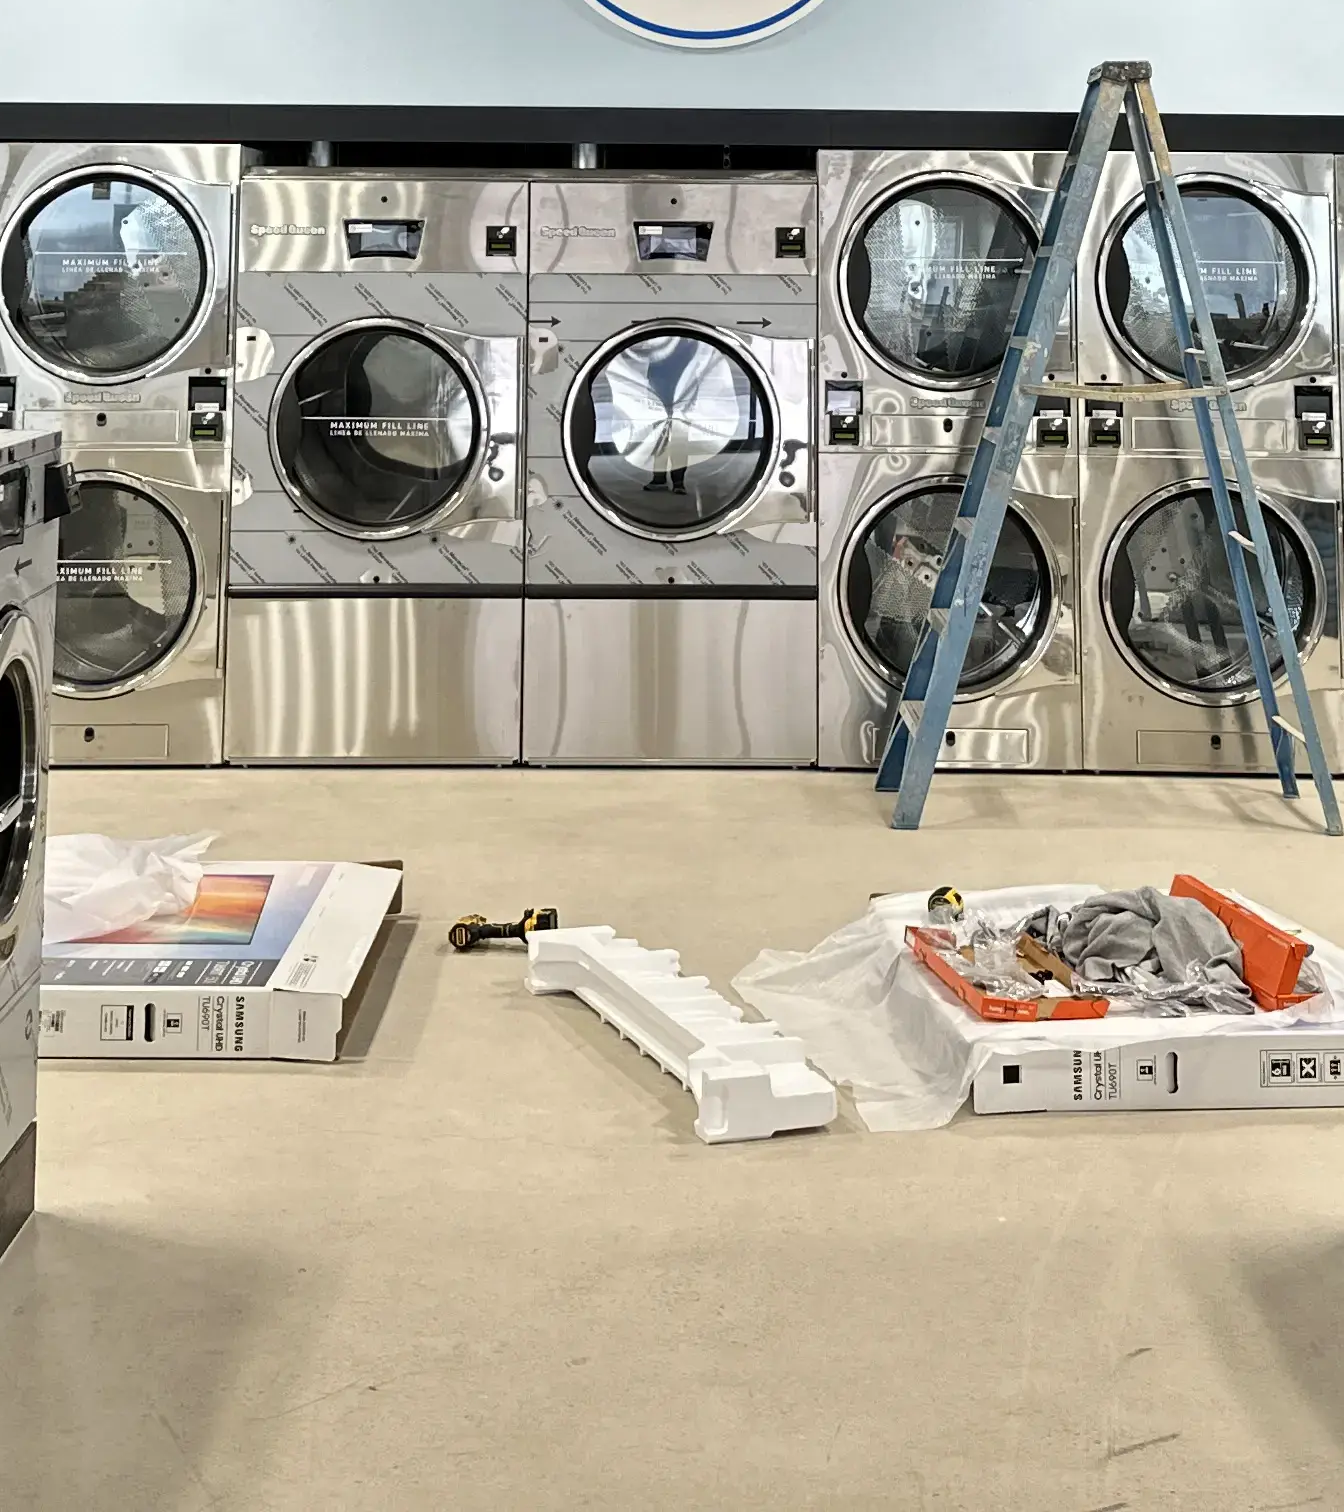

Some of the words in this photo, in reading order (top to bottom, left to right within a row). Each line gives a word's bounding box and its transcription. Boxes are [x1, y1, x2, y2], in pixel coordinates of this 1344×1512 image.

[250, 224, 288, 236] Speed
[288, 224, 327, 235] Queen
[540, 225, 579, 239] Speed
[579, 225, 616, 238] Queen
[1211, 267, 1232, 275] FILL
[1236, 267, 1258, 275] LINE
[63, 391, 103, 405] Speed
[909, 396, 949, 409] Speed
[330, 421, 378, 430] MAXIMUM
[381, 422, 402, 430] FILL
[407, 422, 429, 430] LINE
[96, 567, 117, 575] FILL
[121, 567, 143, 575] LINE
[213, 996, 225, 1033] Crystal
[234, 996, 245, 1052] SAMSUNG
[215, 1033, 223, 1052] UHD
[1072, 1049, 1083, 1101] SAMSUN
[1093, 1063, 1105, 1101] Crystal
